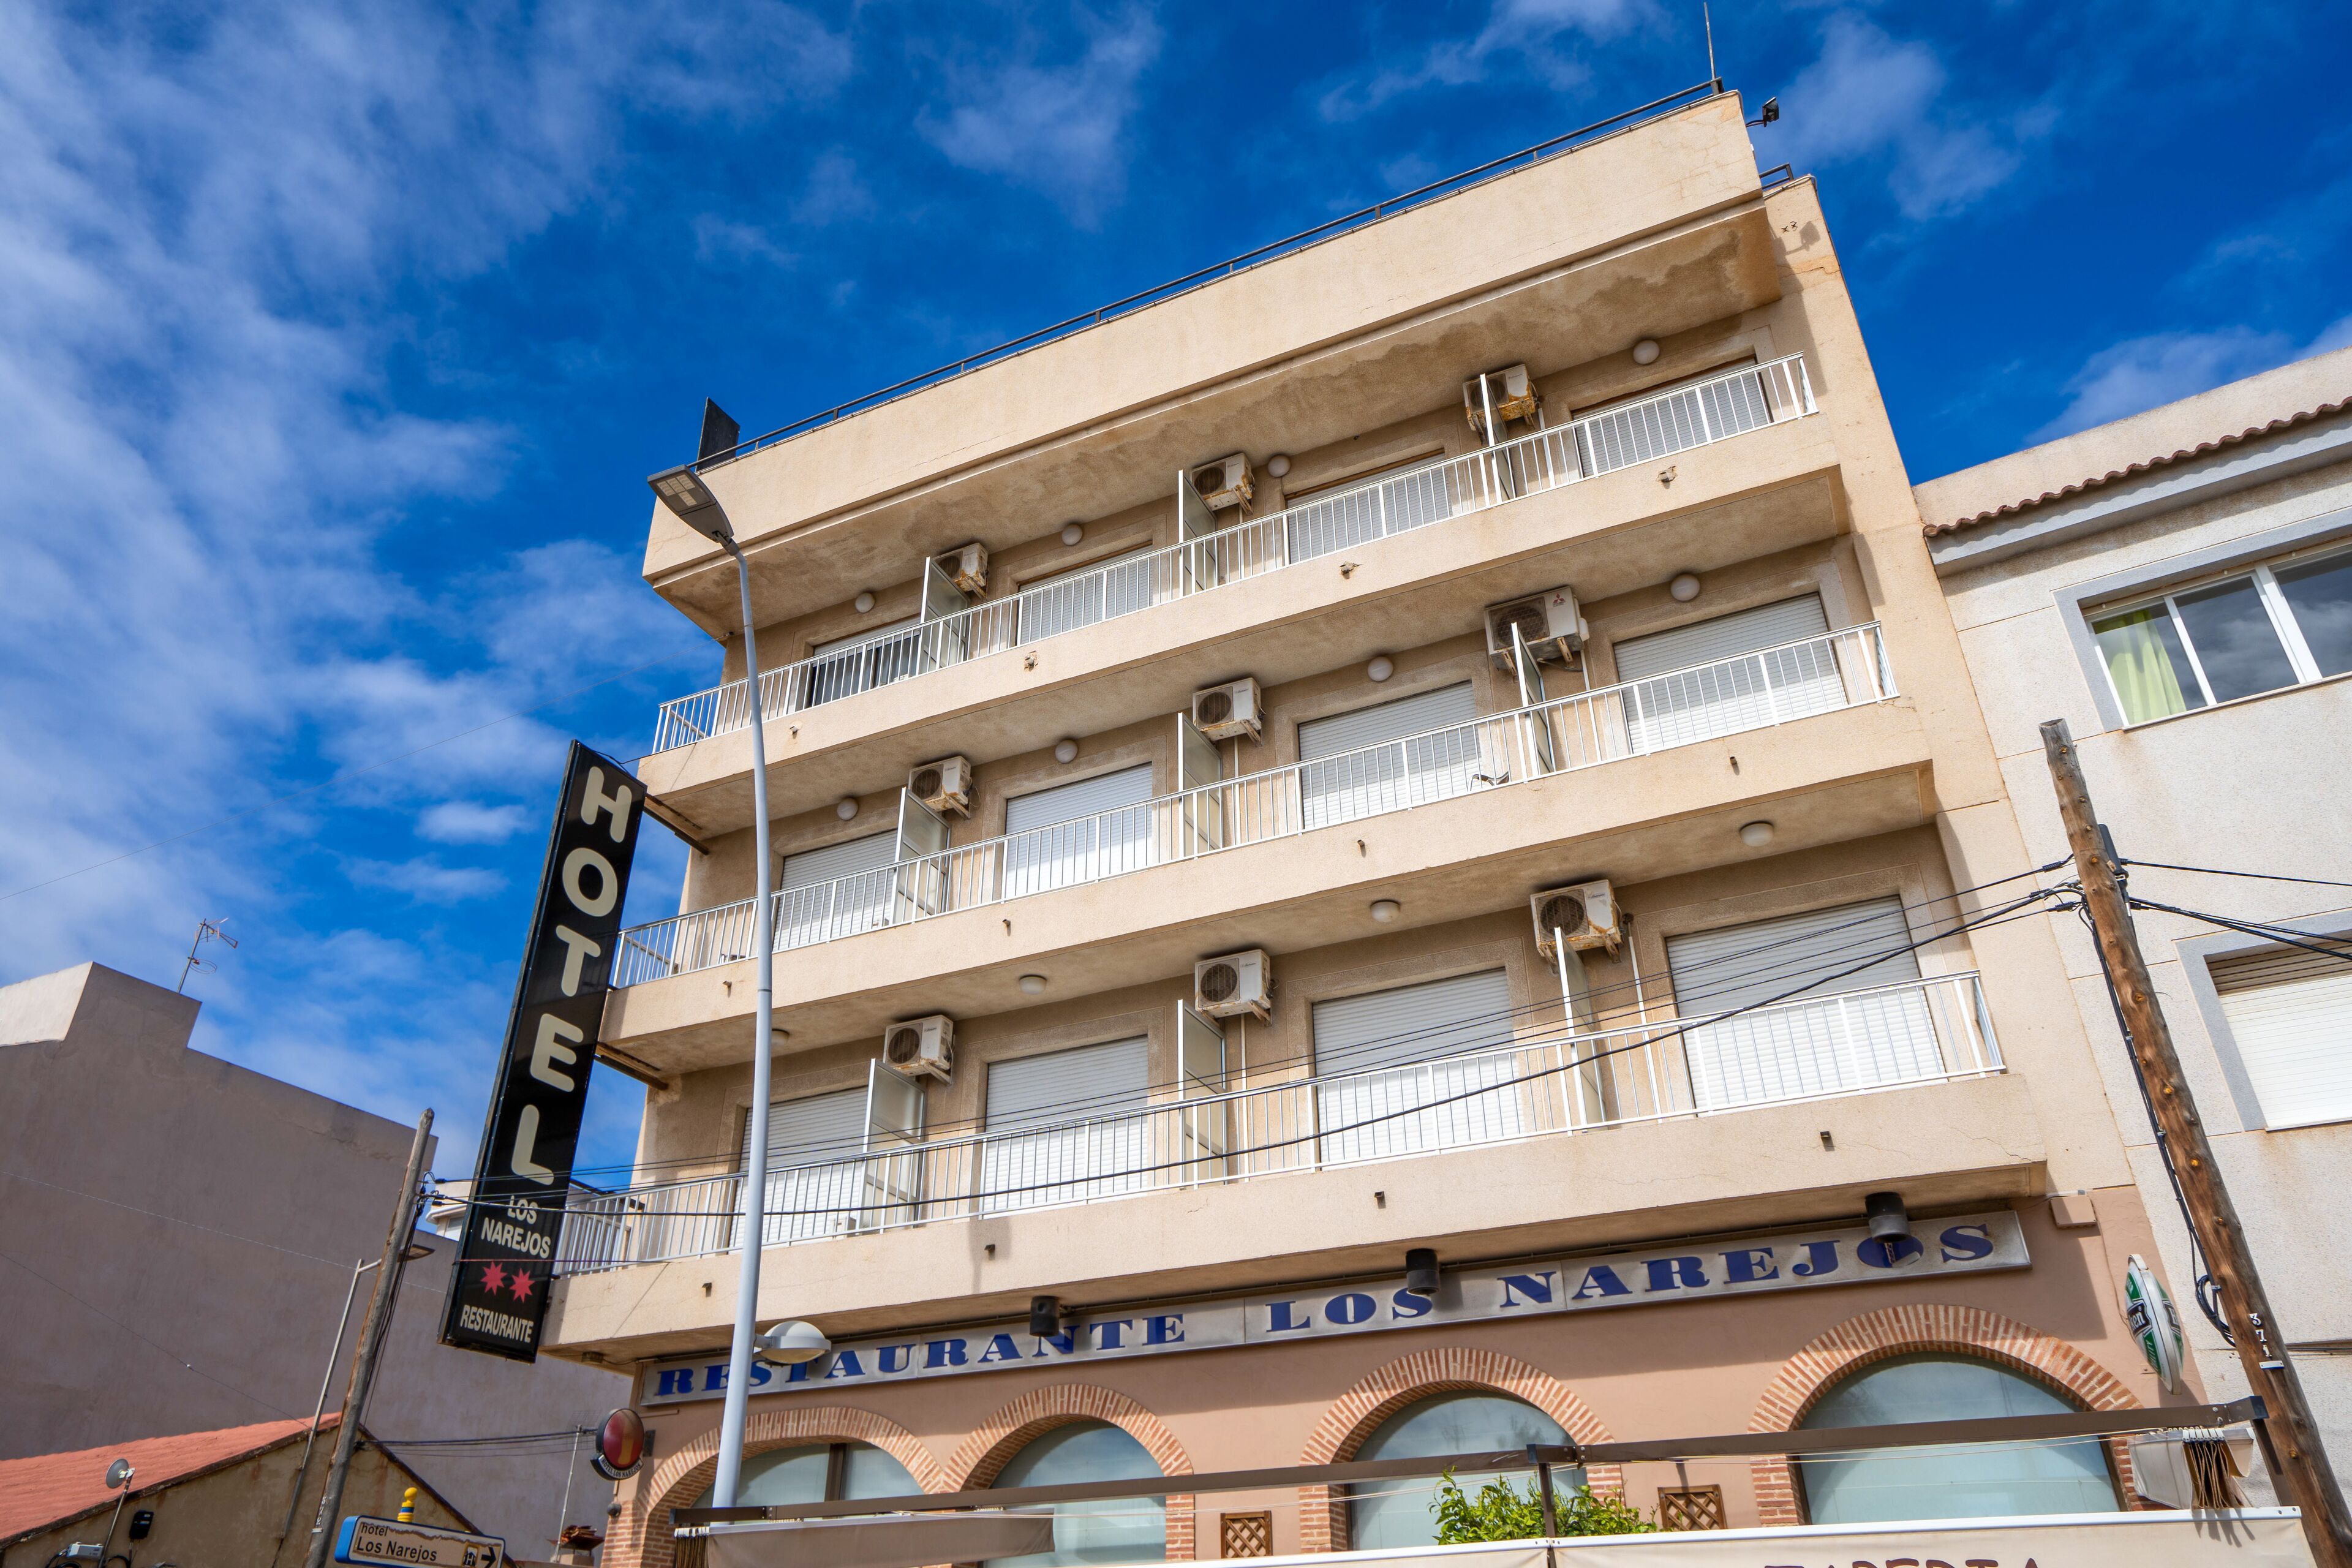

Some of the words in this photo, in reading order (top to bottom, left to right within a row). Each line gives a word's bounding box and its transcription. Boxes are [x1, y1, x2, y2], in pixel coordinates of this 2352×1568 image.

[511, 766, 632, 1185] HOTEL
[507, 1195, 538, 1224] LOS
[481, 1217, 551, 1259] NAREJOS
[460, 1305, 534, 1343] RESTAURANTE
[655, 1314, 1185, 1396] RESTAURANTE
[1265, 1287, 1433, 1332] LOS
[1497, 1224, 1994, 1308] NAREJOS
[601, 1459, 613, 1475] HOTEL
[361, 1523, 388, 1537] hotel
[356, 1536, 382, 1553] Los
[386, 1540, 437, 1562] Narejos
